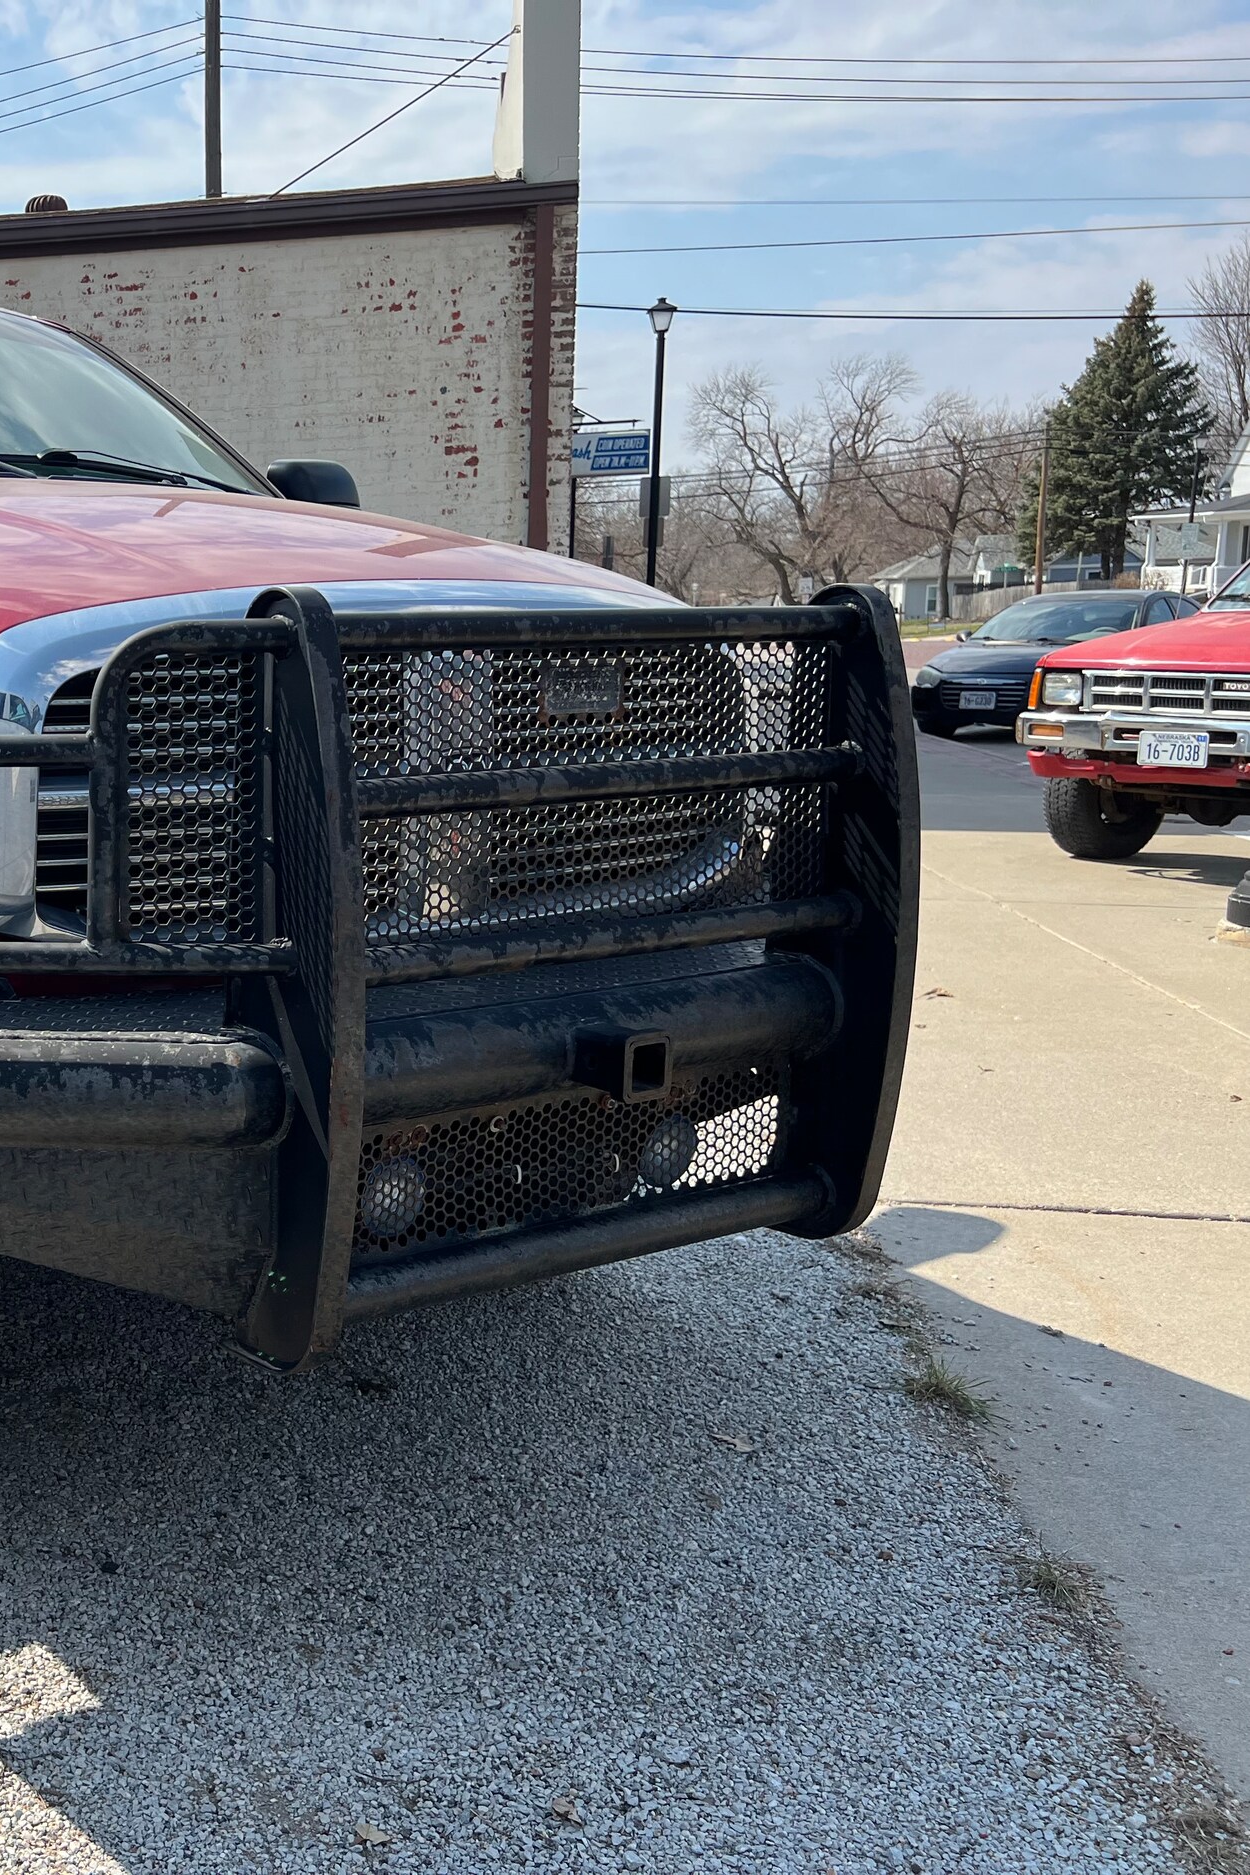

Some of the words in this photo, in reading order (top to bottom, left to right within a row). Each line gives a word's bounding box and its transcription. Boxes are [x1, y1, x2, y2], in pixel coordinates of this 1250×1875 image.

[597, 439, 613, 451] COIN
[613, 437, 645, 450] OPERATED
[593, 456, 611, 468] OPEN
[1224, 682, 1250, 690] TOYO
[1147, 743, 1200, 761] 16-703B
